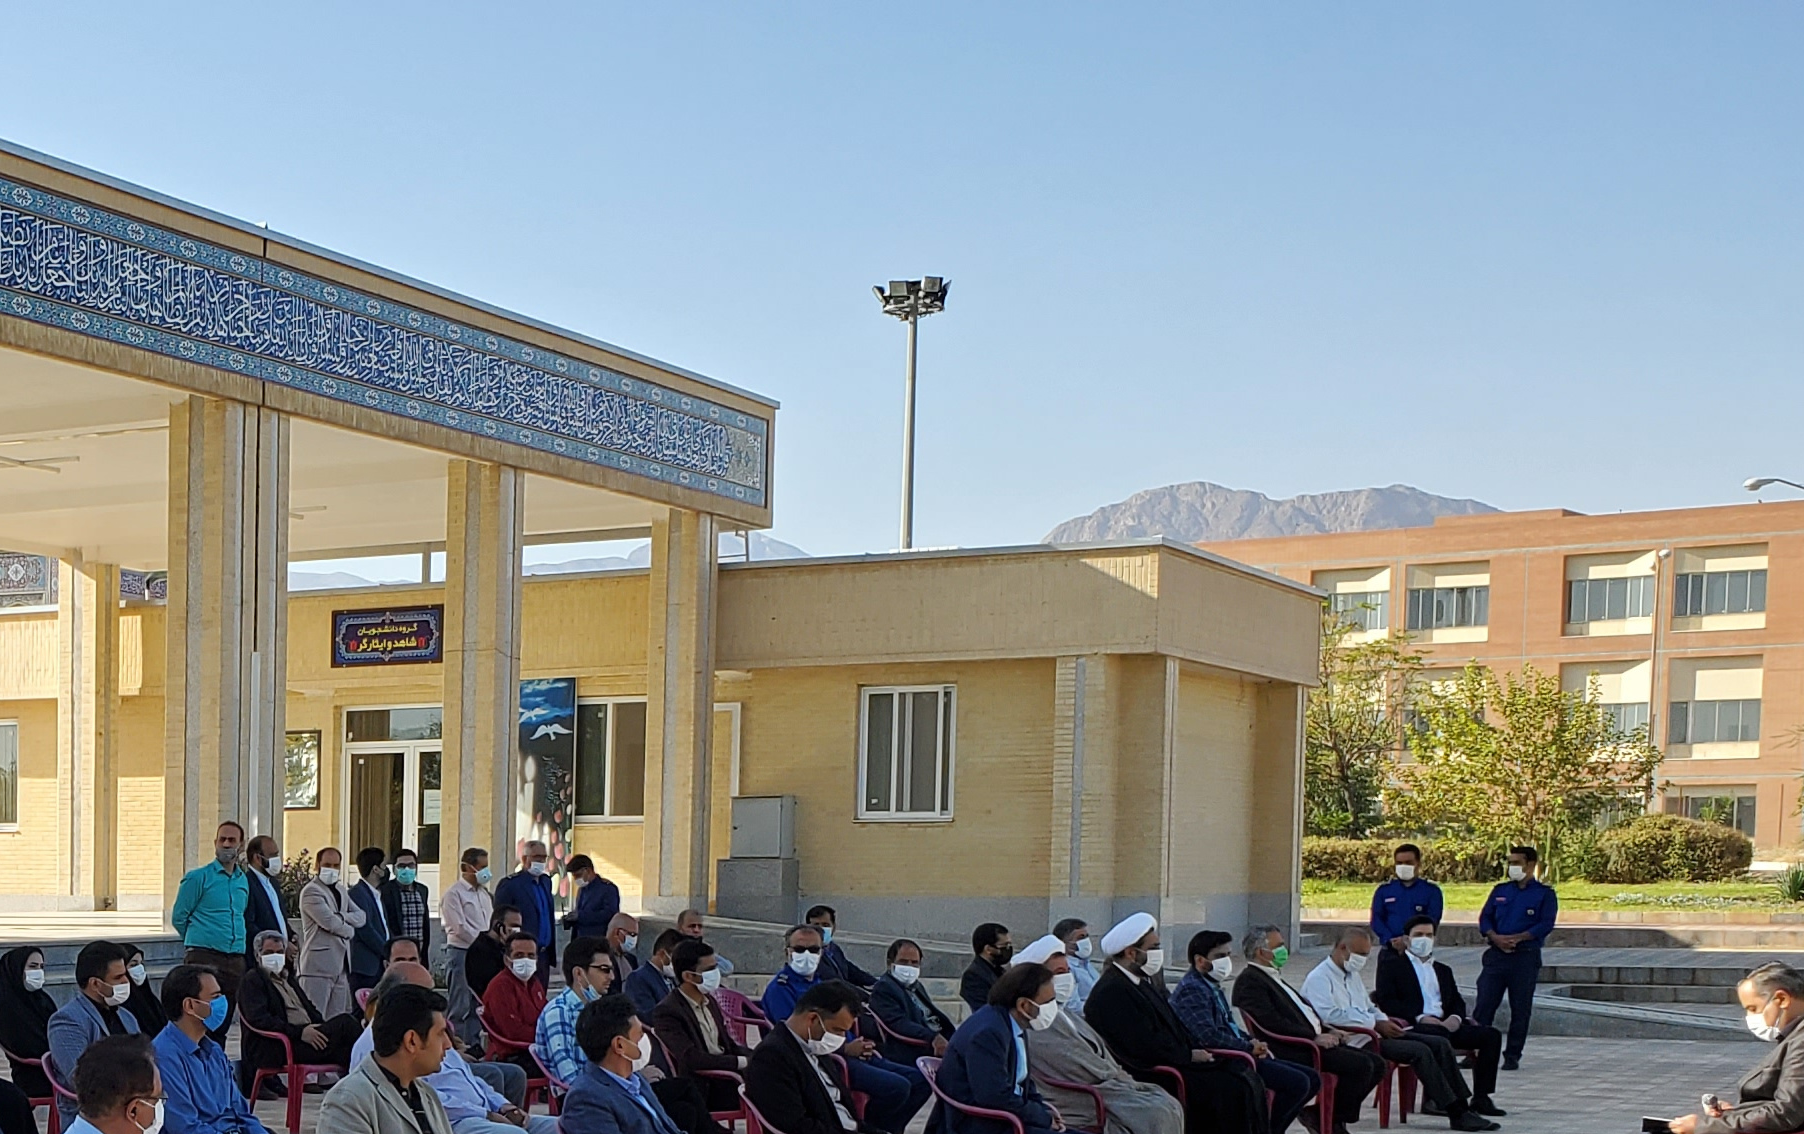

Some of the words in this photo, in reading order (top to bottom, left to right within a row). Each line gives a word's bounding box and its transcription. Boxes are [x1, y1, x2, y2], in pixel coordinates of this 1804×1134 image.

[357, 624, 398, 636] دانشجویان
[398, 622, 418, 634] گروه
[357, 637, 386, 652] ایثارگر
[393, 635, 417, 648] شاهد
